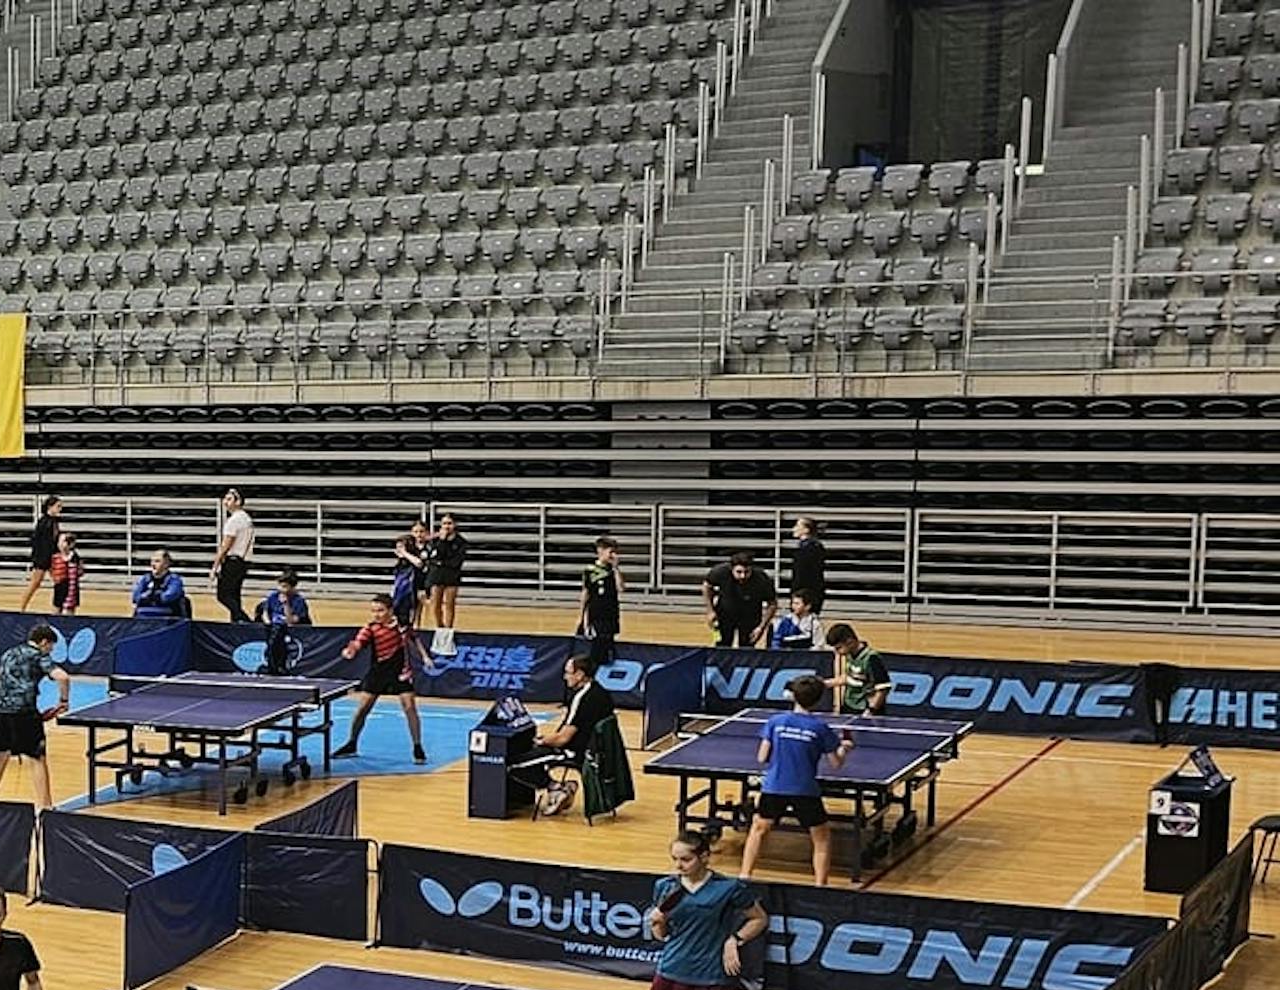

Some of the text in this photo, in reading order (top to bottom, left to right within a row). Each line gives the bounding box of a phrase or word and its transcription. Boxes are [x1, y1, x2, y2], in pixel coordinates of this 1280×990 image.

[470, 671, 531, 690] DHS
[888, 671, 1135, 719] DONIC
[508, 884, 655, 941] Butter
[563, 941, 662, 962] www.butterf
